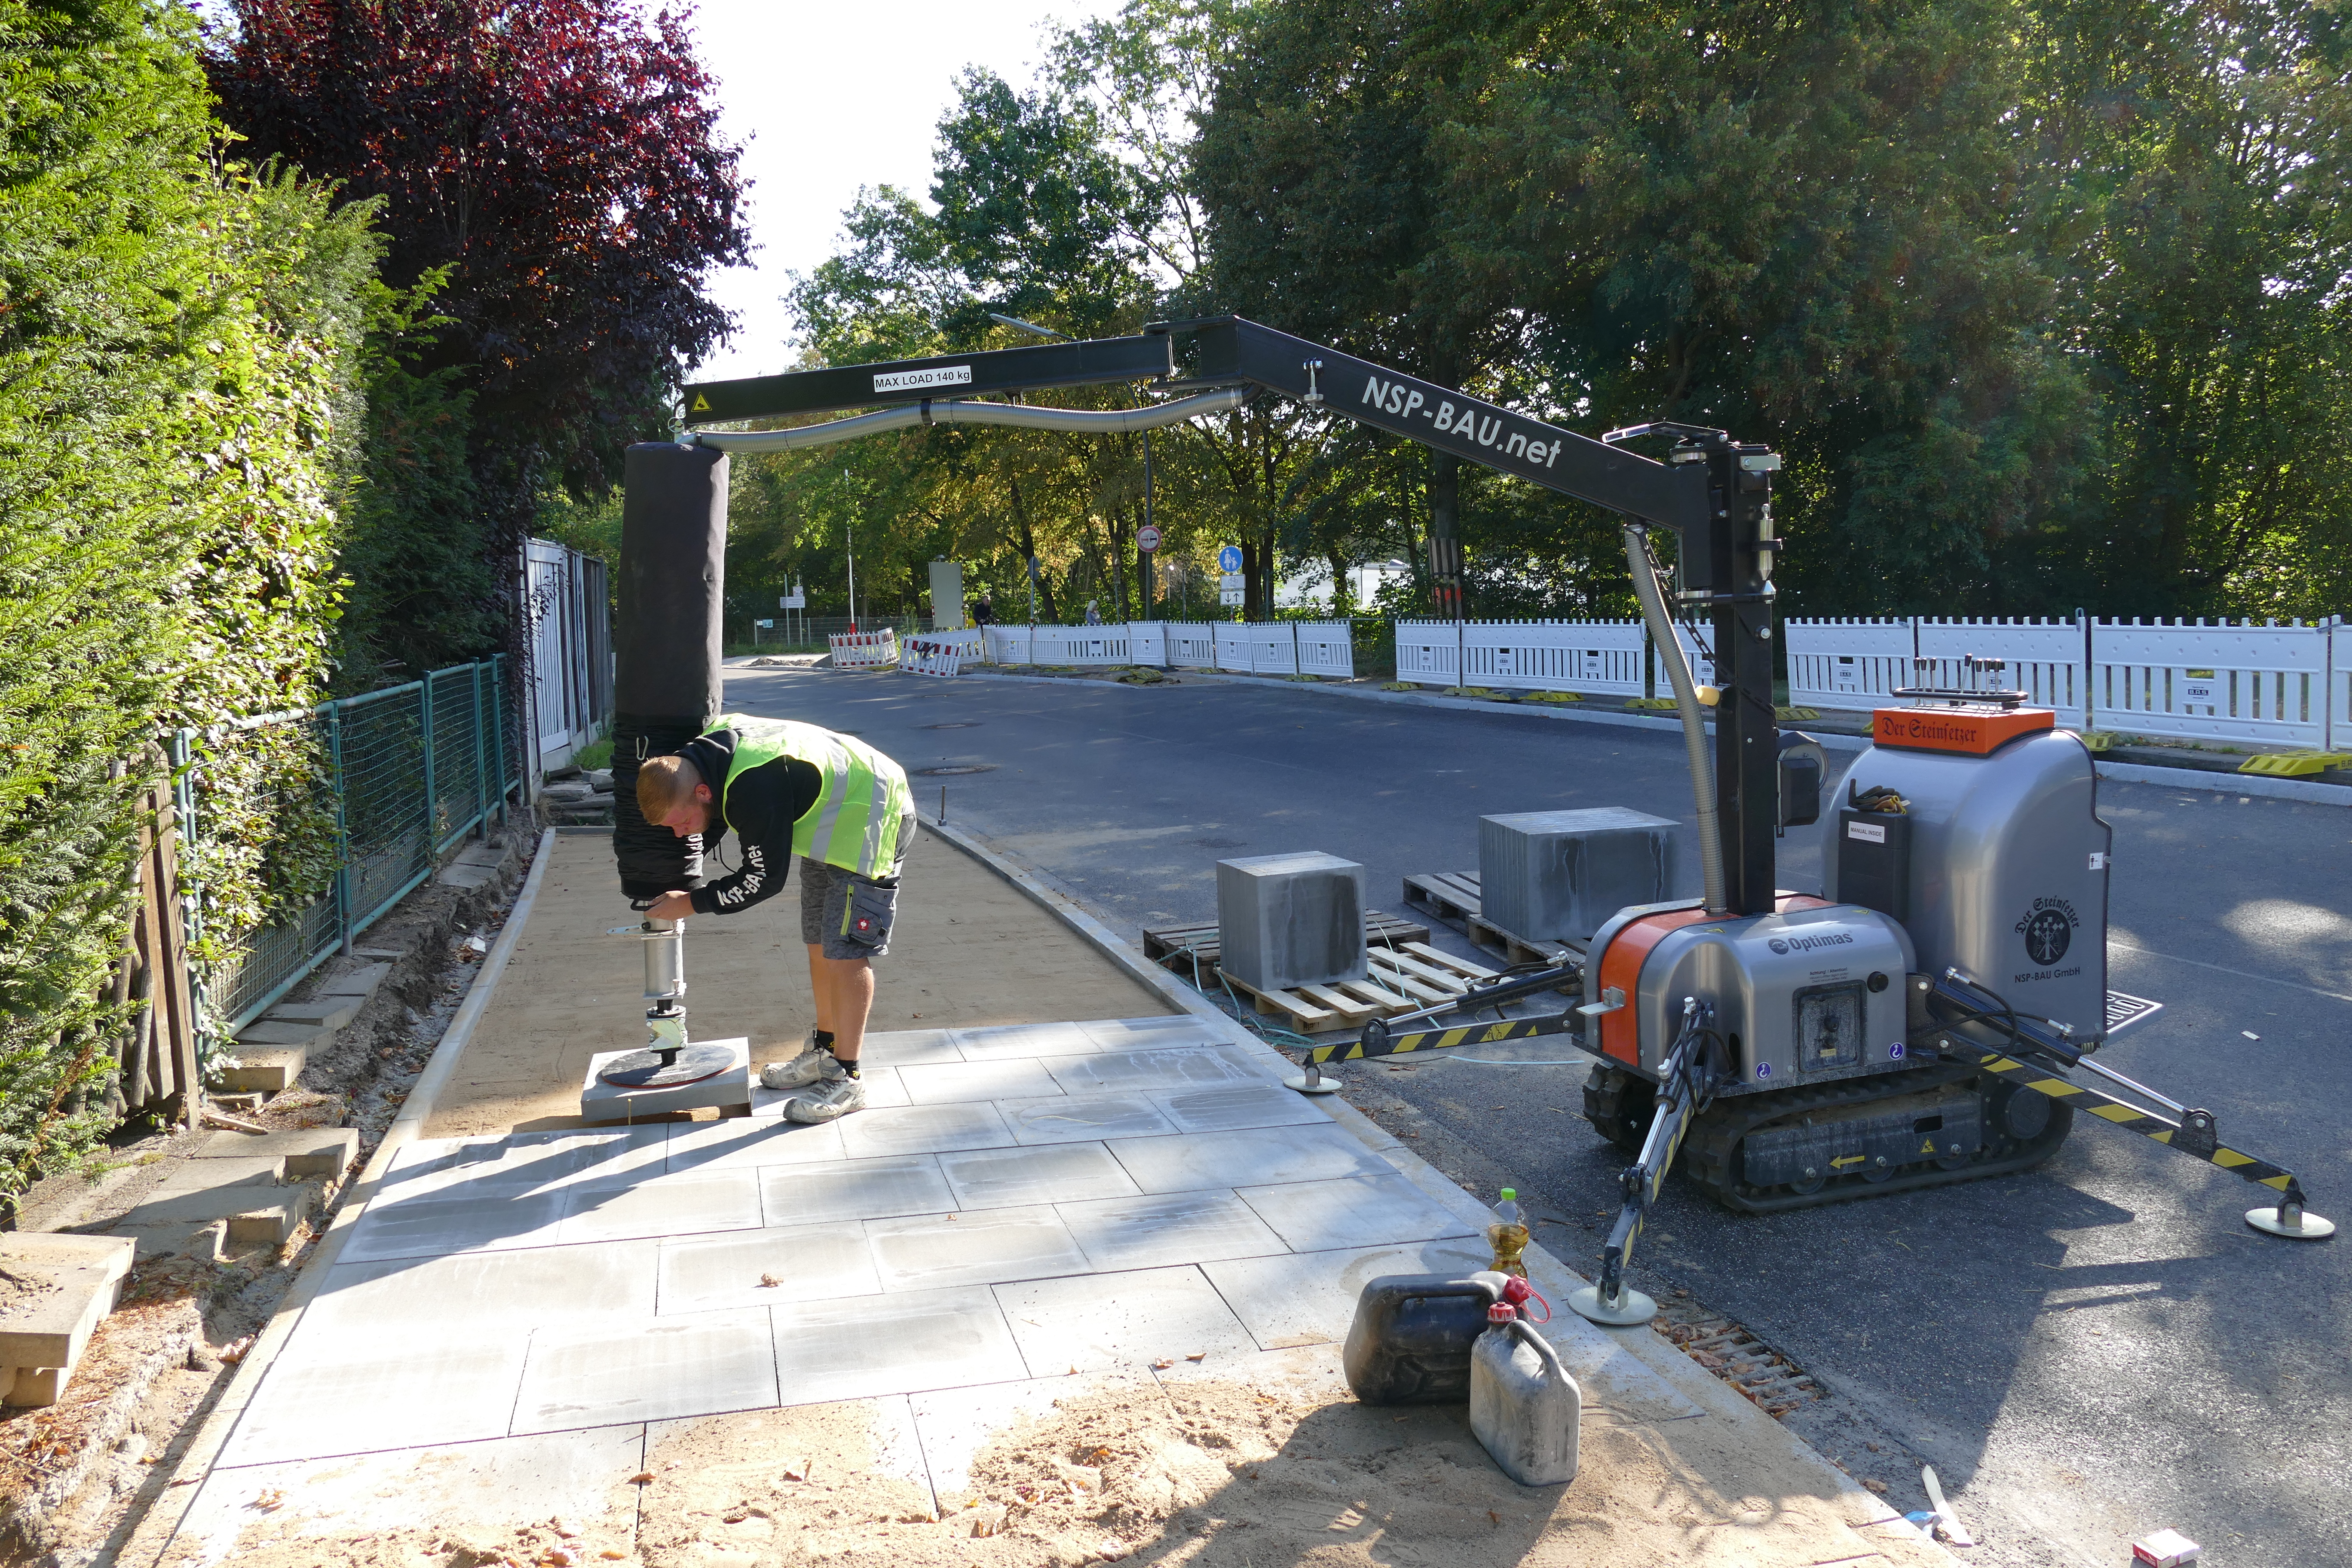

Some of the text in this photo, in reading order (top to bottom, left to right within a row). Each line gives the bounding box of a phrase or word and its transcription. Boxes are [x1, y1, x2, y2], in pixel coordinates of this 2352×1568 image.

[876, 371, 970, 388] MAX LOAD 140 kg
[1362, 376, 1562, 468] NSP-BAU.net
[1882, 717, 1905, 736] Der
[2015, 910, 2032, 935] Der
[1788, 933, 1853, 952] Optimas
[2015, 967, 2080, 983] NSP-BAU GmbH
[2138, 1551, 2156, 1567] Winston
